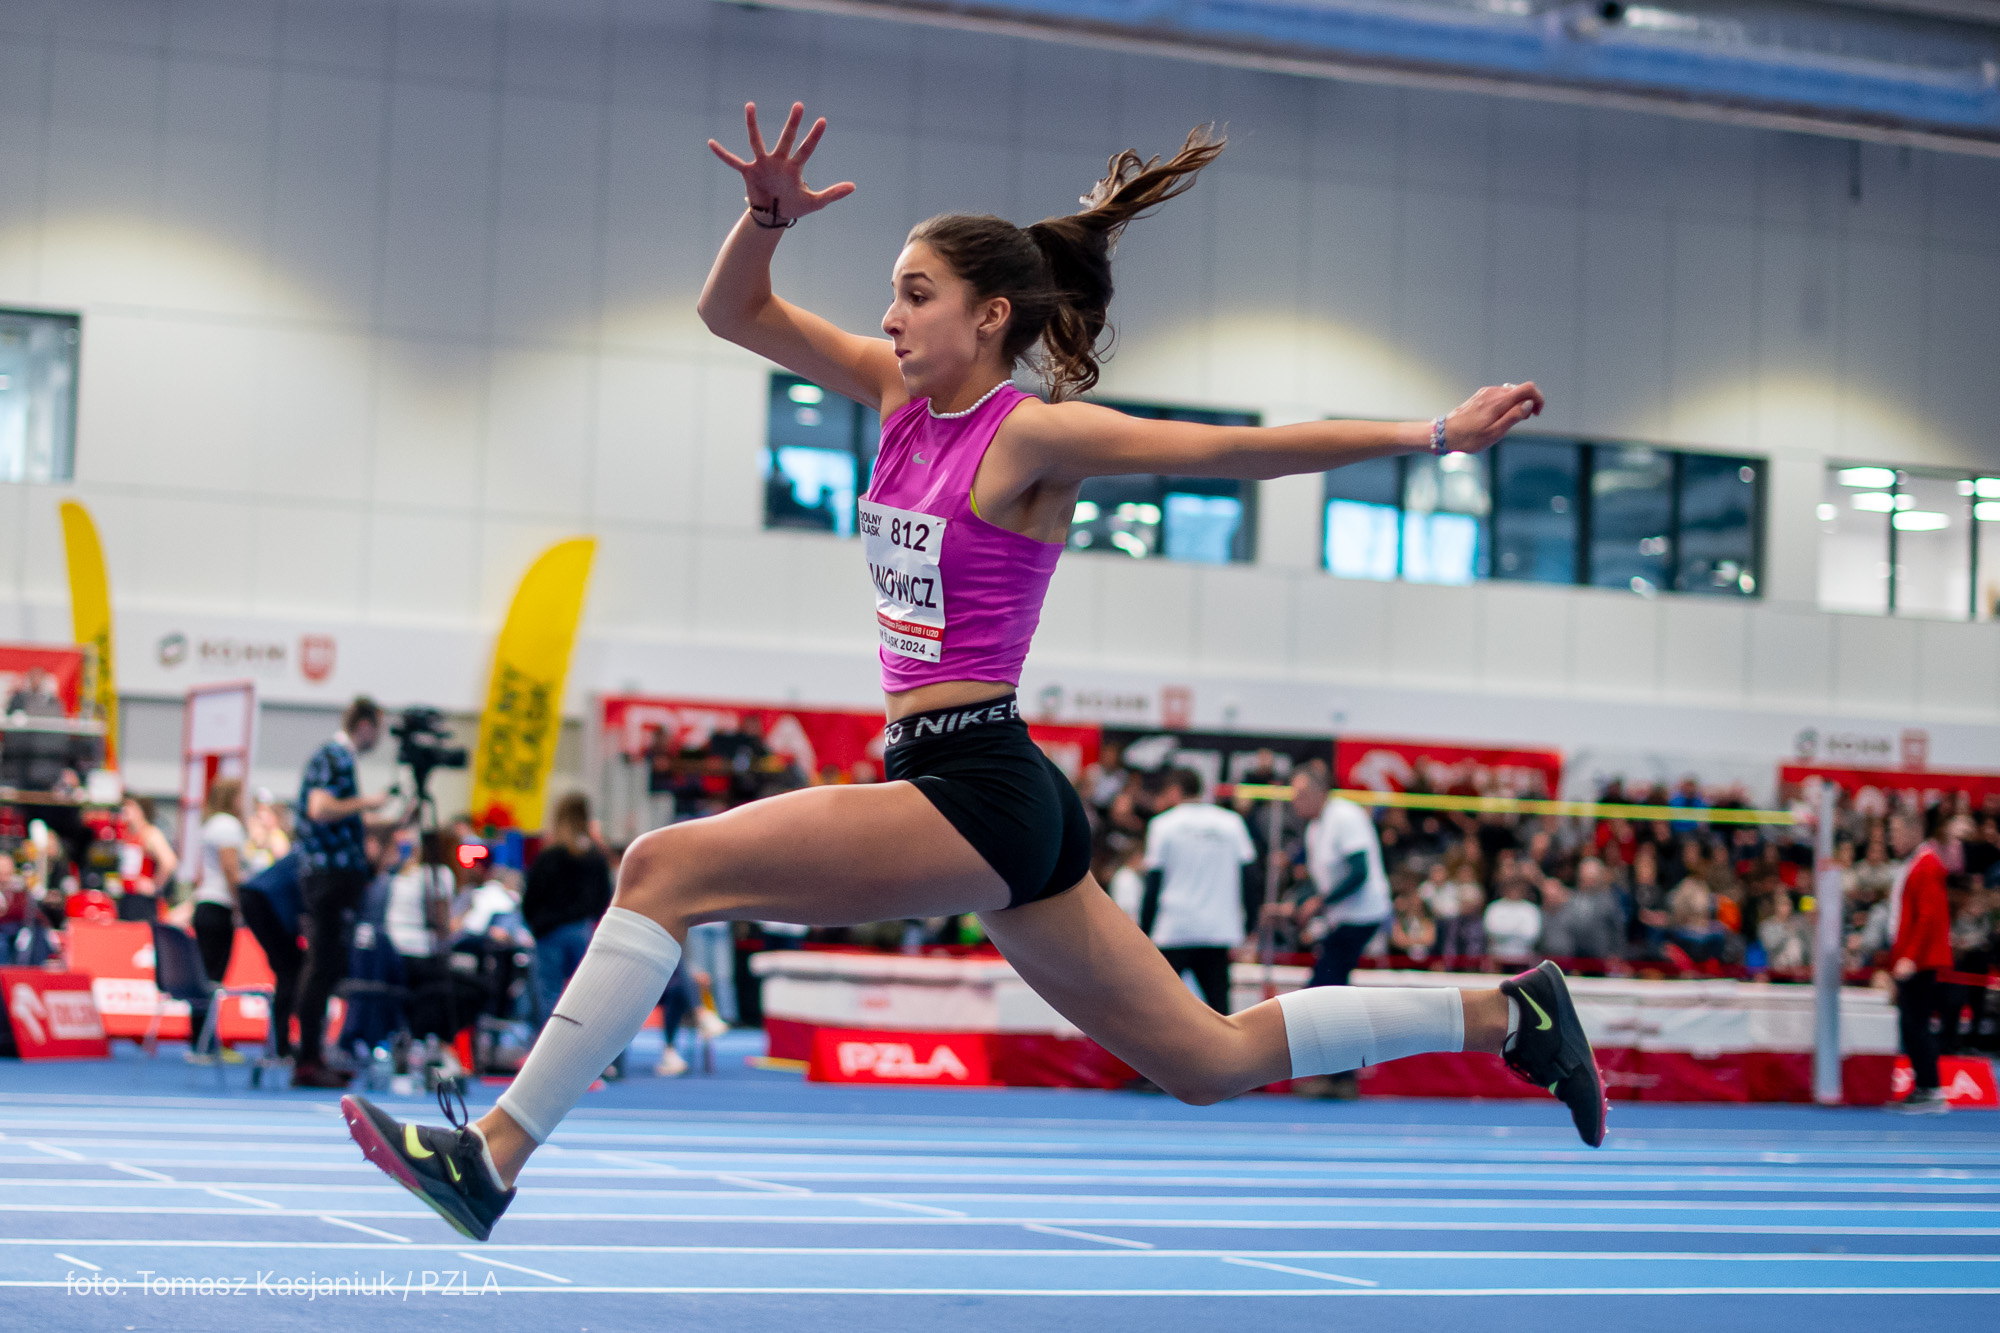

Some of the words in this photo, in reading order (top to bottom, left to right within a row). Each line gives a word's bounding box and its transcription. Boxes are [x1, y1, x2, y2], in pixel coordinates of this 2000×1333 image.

[891, 517, 930, 552] 812
[900, 639, 926, 655] 2024
[914, 703, 1007, 738] NIKE
[838, 1042, 969, 1080] PZLA
